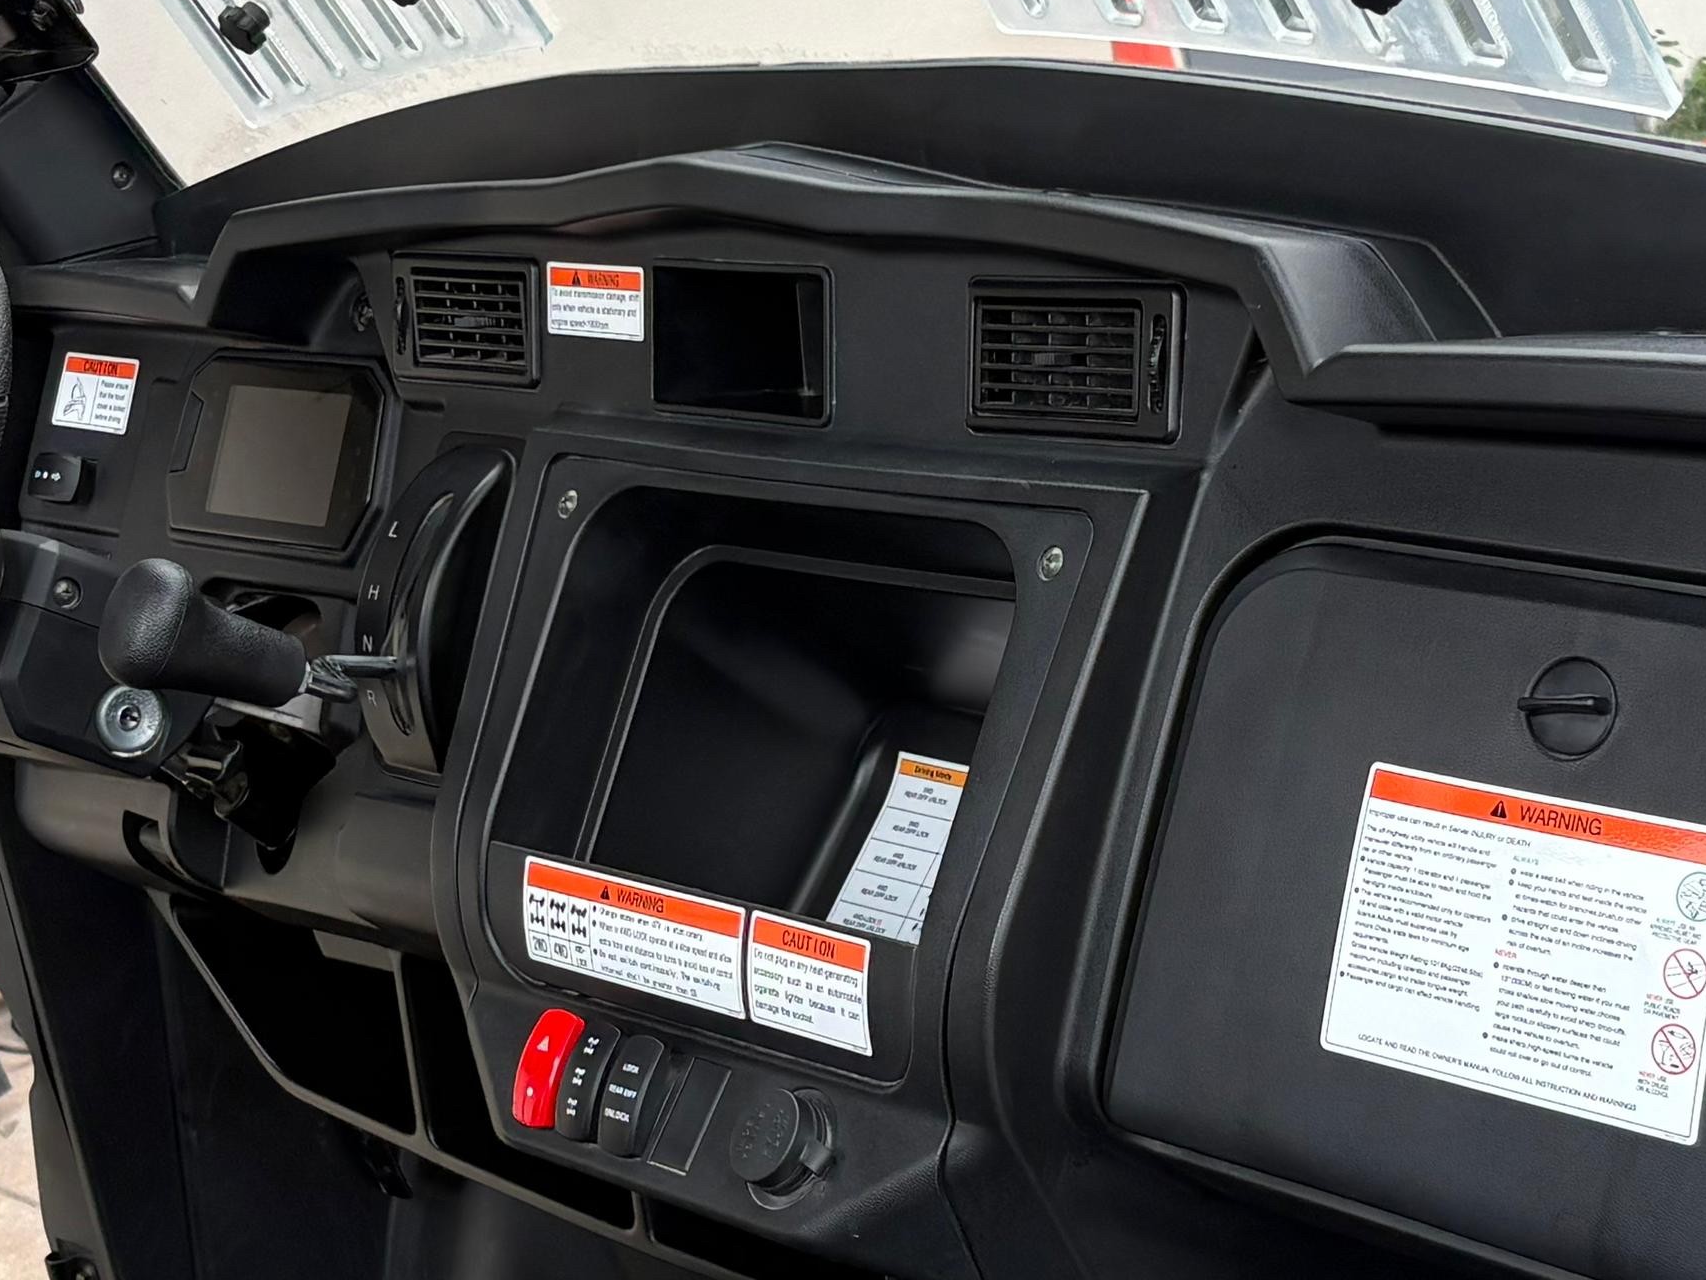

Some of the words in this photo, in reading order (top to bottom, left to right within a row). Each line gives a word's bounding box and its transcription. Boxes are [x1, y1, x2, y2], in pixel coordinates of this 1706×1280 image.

[389, 521, 398, 538] L
[368, 584, 380, 601] H
[362, 634, 373, 652] N
[367, 690, 377, 706] R
[1520, 804, 1603, 836] WARNING
[616, 888, 663, 913] WARNING
[782, 928, 835, 959] CAUTION
